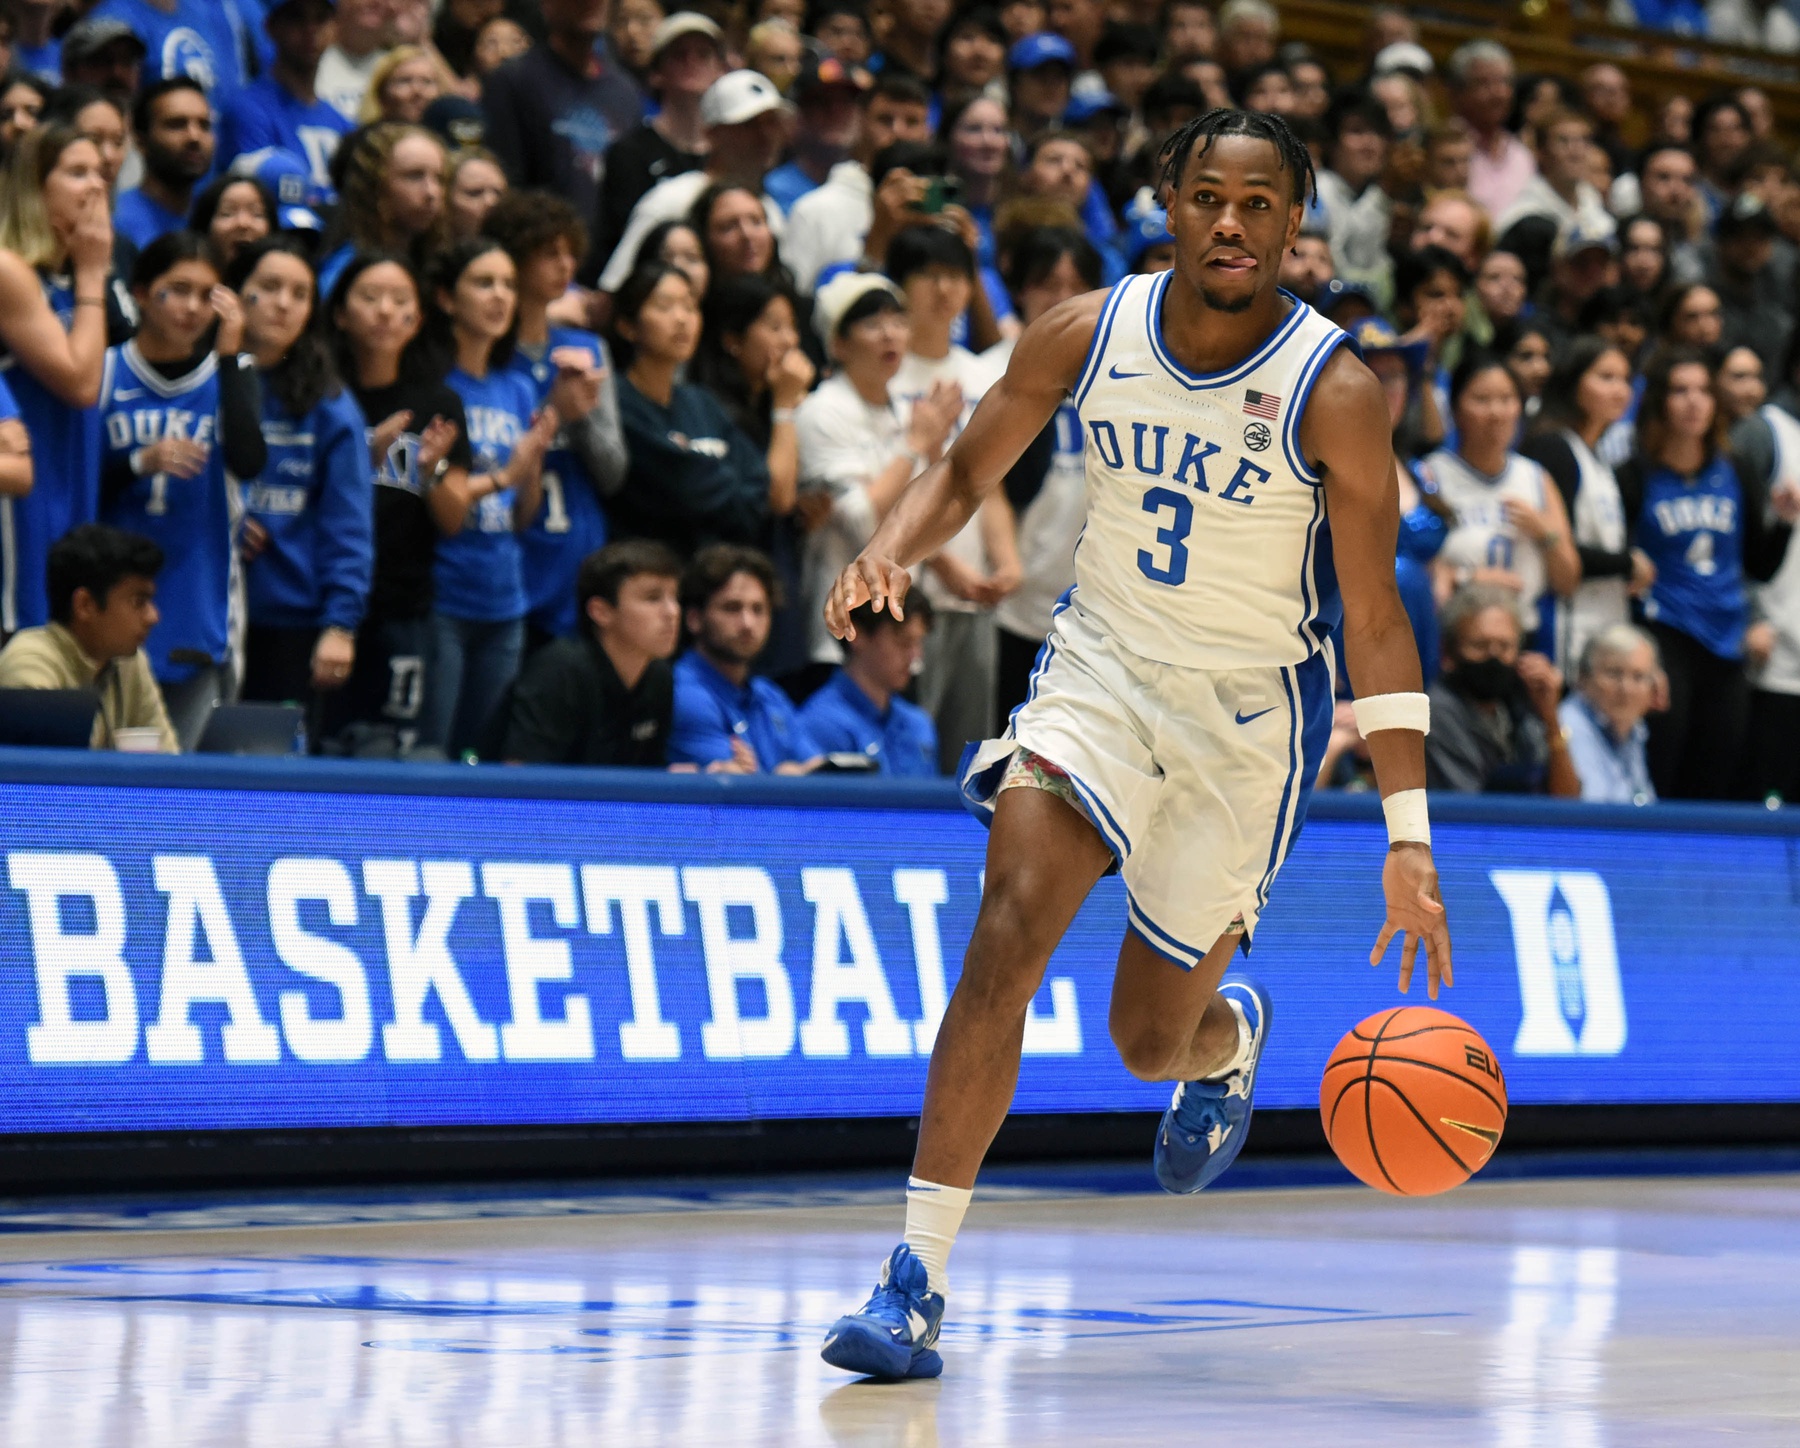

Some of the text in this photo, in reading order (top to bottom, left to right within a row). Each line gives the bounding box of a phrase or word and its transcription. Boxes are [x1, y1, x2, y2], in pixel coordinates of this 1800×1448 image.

[1088, 420, 1272, 505] DUKE
[1137, 486, 1194, 586] 3
[1464, 1044, 1503, 1086] ELI
